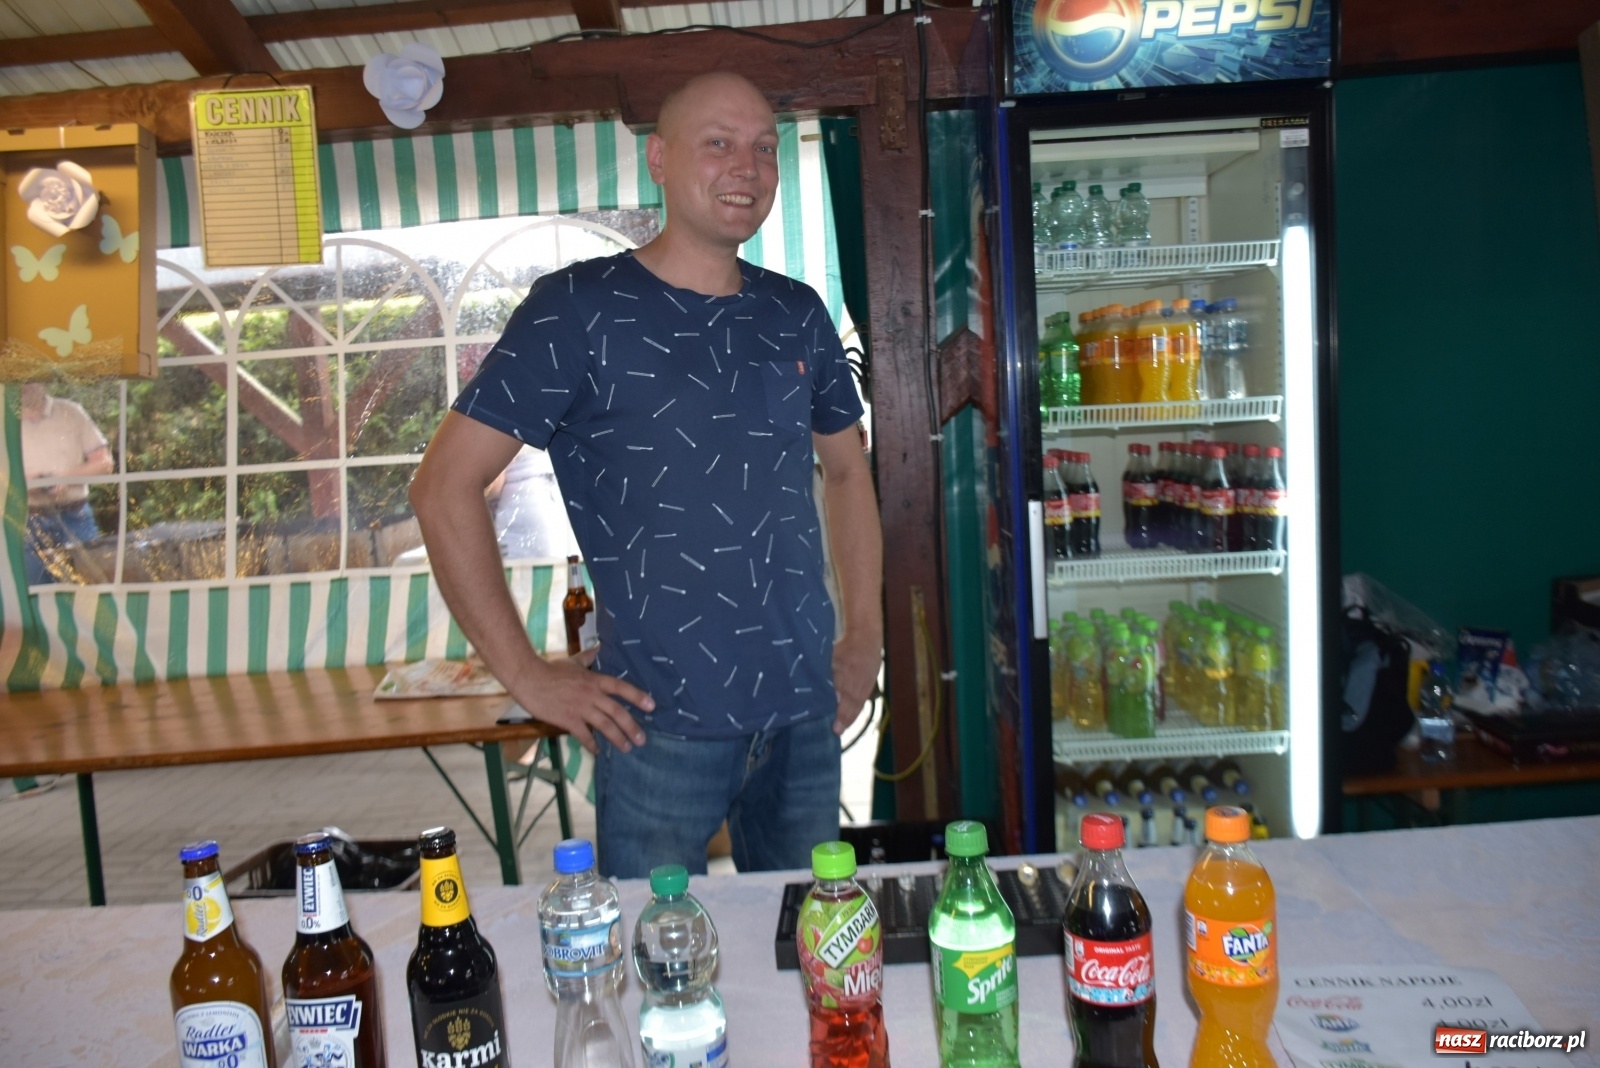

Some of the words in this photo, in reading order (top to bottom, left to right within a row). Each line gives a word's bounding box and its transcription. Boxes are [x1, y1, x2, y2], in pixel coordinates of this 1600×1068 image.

[1140, 0, 1313, 38] PEPSI
[205, 94, 302, 125] CENNIK
[1221, 931, 1269, 956] FANTA
[966, 953, 1013, 1005] Sprite
[1081, 951, 1151, 988] Coca-Cola
[1293, 975, 1376, 988] CENNIK
[1379, 974, 1464, 987] NAPOJE
[184, 1036, 244, 1057] WARKA
[186, 1023, 236, 1039] Radler
[420, 1029, 502, 1068] karmi
